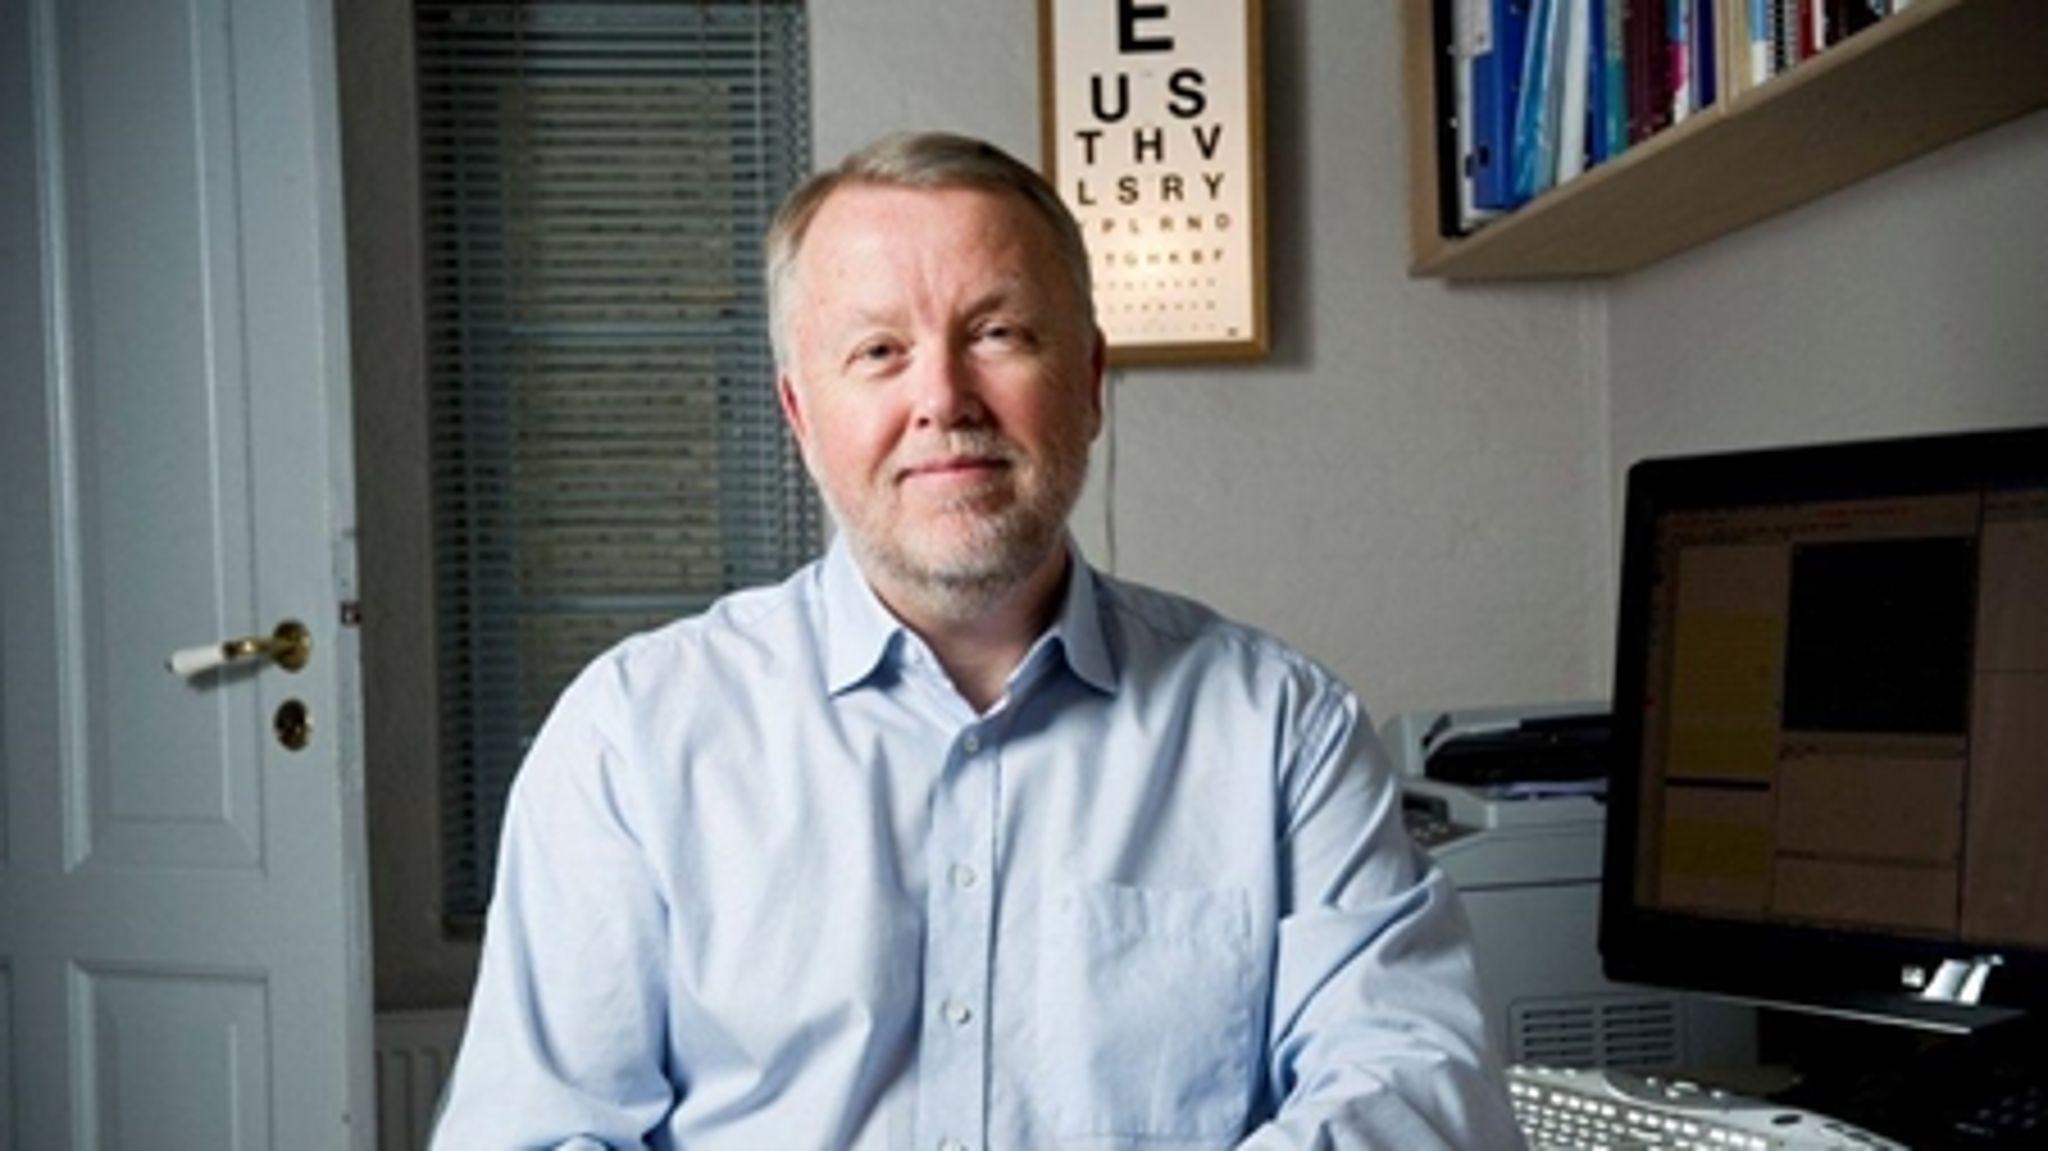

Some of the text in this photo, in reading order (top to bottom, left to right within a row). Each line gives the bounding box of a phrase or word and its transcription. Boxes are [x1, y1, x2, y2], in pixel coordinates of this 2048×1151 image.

[1117, 0, 1174, 54] E
[1091, 68, 1206, 123] U S
[1076, 125, 1221, 164] T H V
[1078, 174, 1223, 205] L S R Y
